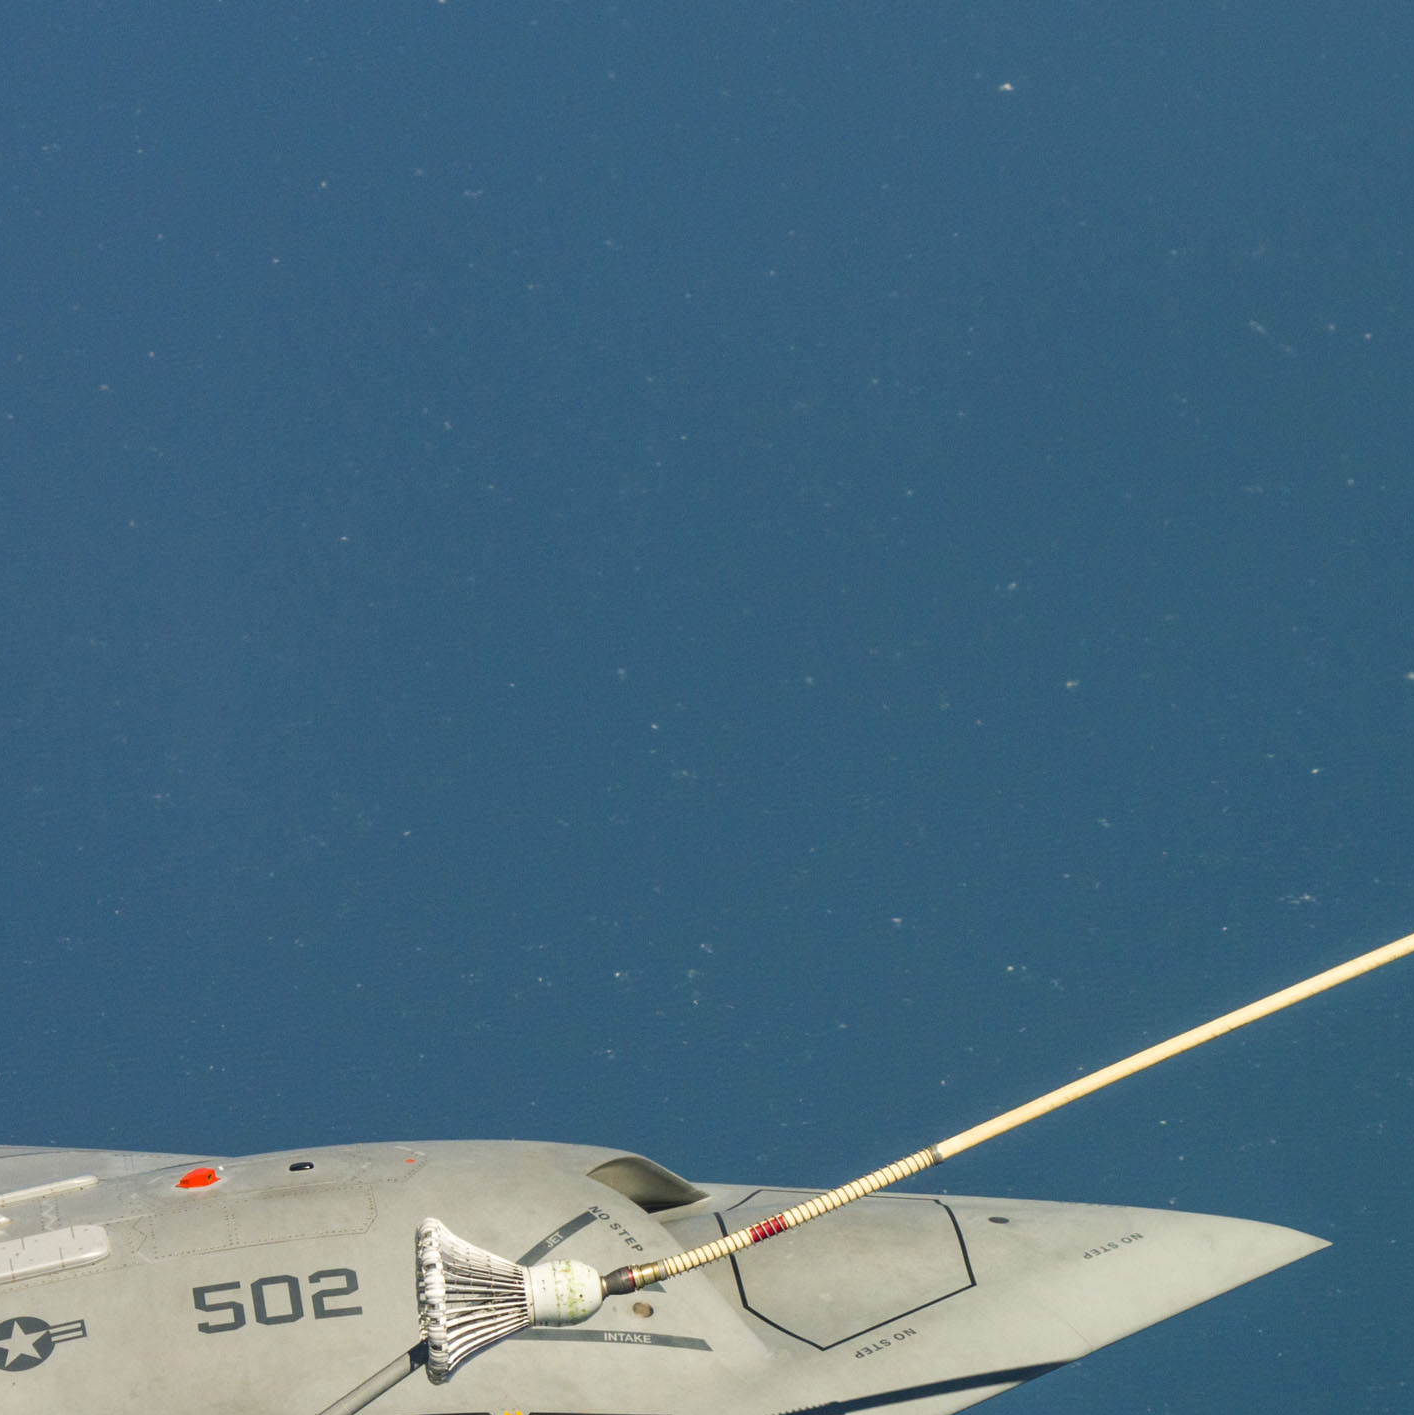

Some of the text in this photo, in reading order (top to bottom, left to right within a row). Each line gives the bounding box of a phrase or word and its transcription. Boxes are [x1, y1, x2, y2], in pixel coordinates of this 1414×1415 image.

[545, 1231, 564, 1249] JET
[588, 1205, 644, 1253] NO STEP
[1083, 1232, 1144, 1260] NO STEP
[192, 1268, 363, 1334] 502
[603, 1331, 652, 1344] INTAKE
[854, 1327, 918, 1359] NO STEP
